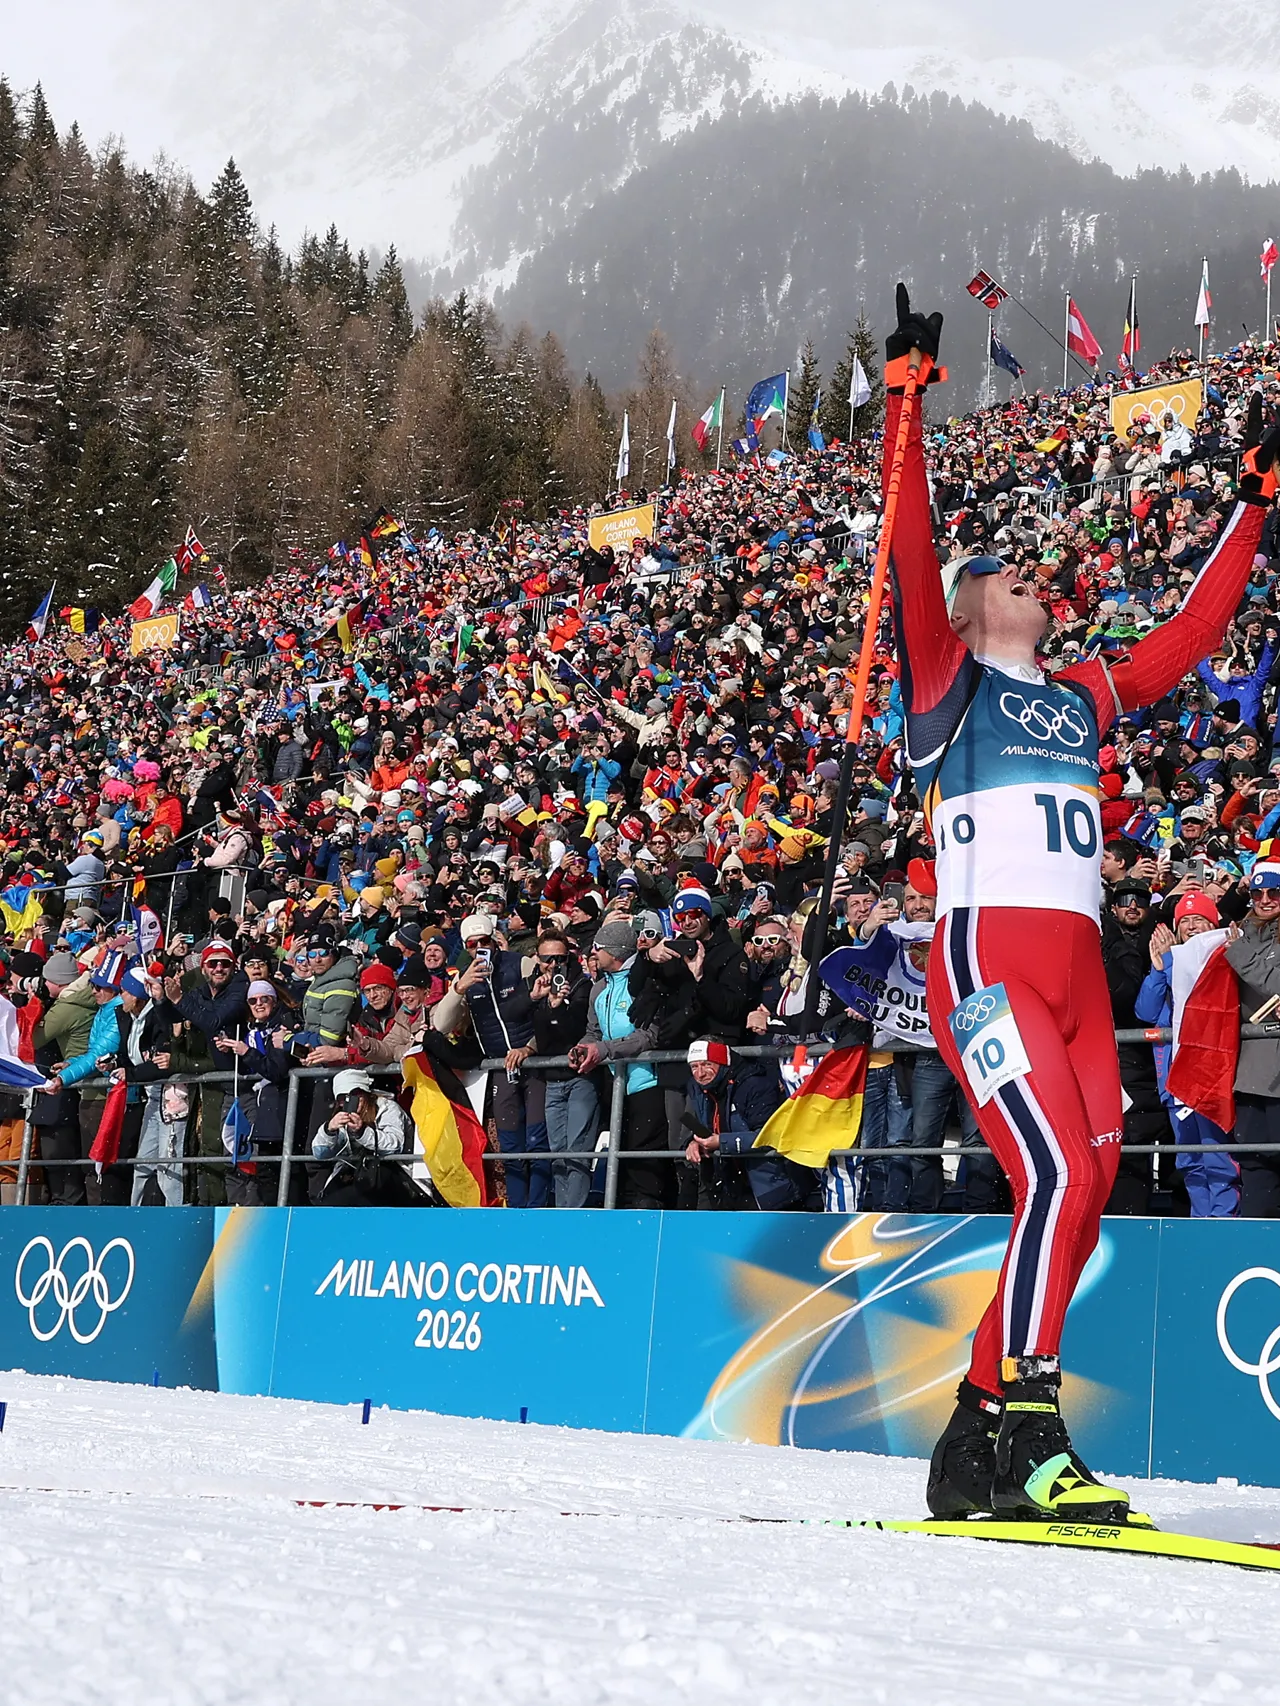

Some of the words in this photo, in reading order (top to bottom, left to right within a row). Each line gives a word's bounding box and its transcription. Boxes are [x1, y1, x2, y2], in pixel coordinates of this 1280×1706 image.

[601, 517, 636, 533] MILANO
[606, 527, 641, 542] CORTINA
[1000, 745, 1049, 757] MILANO
[1050, 751, 1091, 767] CORTINA
[1034, 793, 1098, 859] 10
[895, 1012, 934, 1034] SP
[971, 1037, 1005, 1080] 10
[1090, 1132, 1115, 1147] AFT
[315, 1259, 450, 1301] MILANO
[455, 1262, 605, 1308] CORTINA
[415, 1309, 482, 1351] 2026
[1009, 1403, 1053, 1412] FISCHER
[1046, 1525, 1121, 1540] FISCHER
